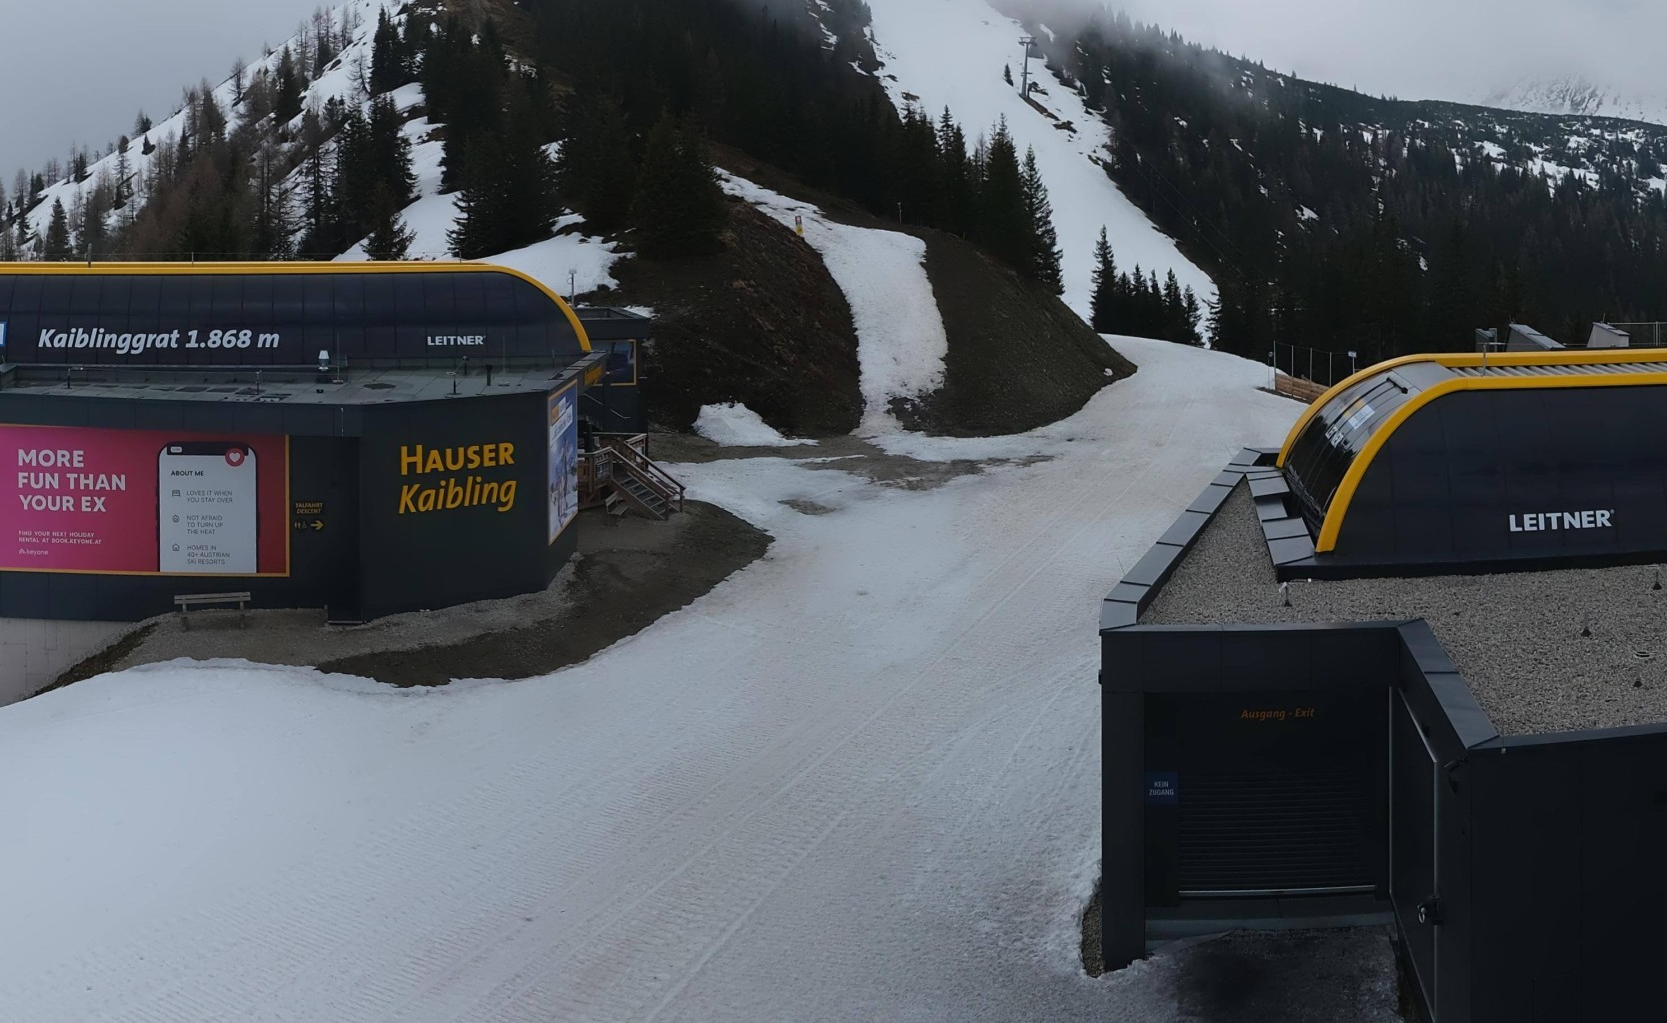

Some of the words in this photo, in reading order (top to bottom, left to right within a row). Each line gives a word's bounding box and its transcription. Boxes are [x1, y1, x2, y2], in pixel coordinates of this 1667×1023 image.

[38, 327, 179, 355] Kaiblinggrat
[185, 329, 251, 348] 1.868
[257, 333, 280, 348] m
[427, 335, 484, 345] LEITNER
[18, 449, 84, 467] MORE
[401, 442, 515, 475] HAUSER
[18, 472, 59, 489] FUN
[66, 473, 126, 491] THAN
[19, 495, 75, 511] YOUR
[81, 496, 106, 512] EX
[398, 476, 517, 514] Kaibling
[1509, 509, 1612, 532] LEITNER
[1241, 709, 1286, 721] Ausgang
[1294, 707, 1315, 718] Exit
[1148, 788, 1174, 796] ZUGANG
